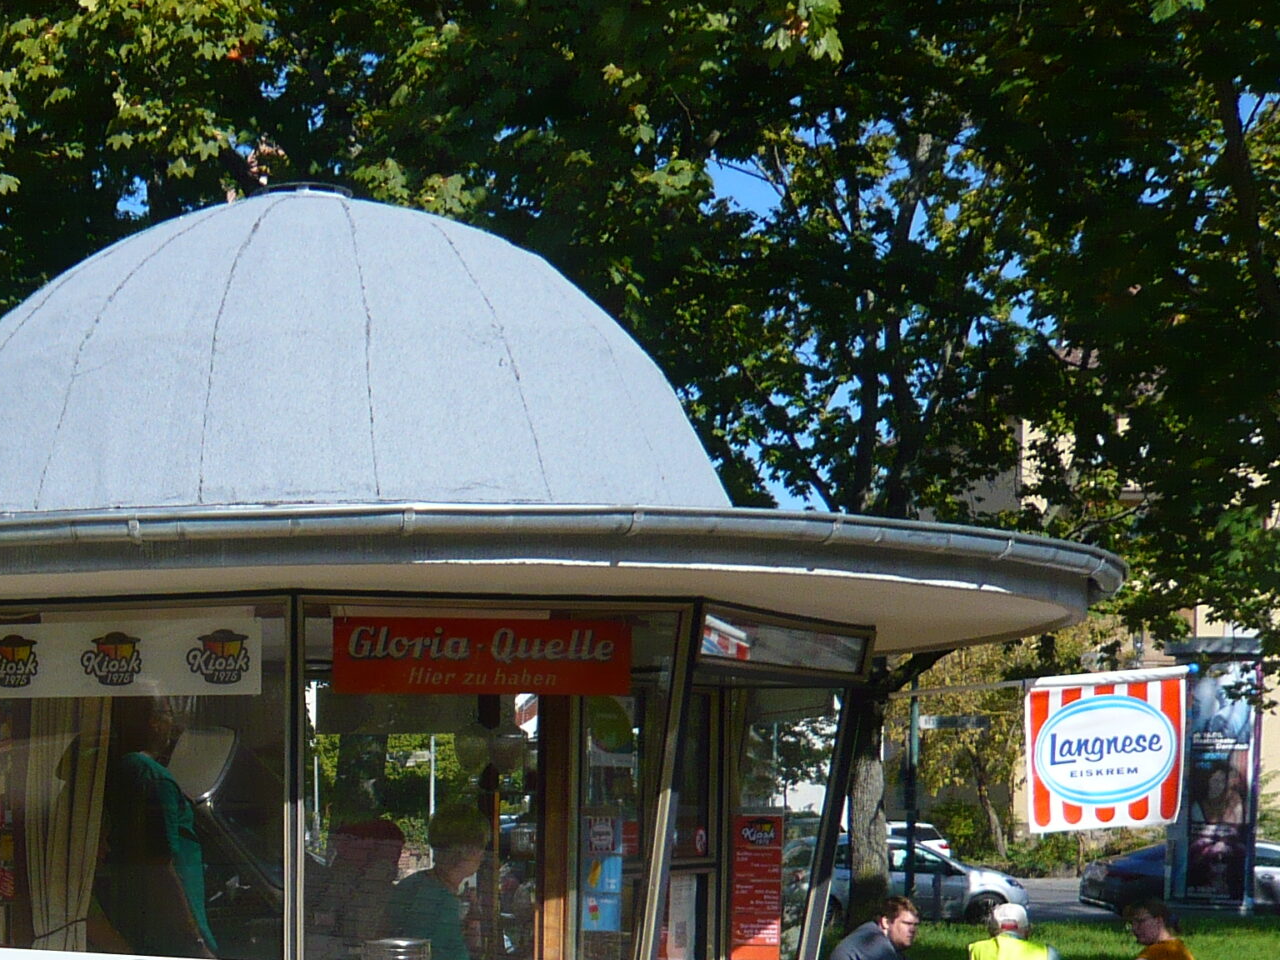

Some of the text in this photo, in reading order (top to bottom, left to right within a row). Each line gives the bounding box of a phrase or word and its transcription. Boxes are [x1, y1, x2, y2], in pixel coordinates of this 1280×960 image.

[349, 626, 471, 661] Gloria
[491, 627, 615, 664] Quelle
[82, 652, 141, 677] Kiosk
[188, 649, 249, 675] Kiosk
[408, 667, 557, 687] Hier zu haben
[1050, 732, 1163, 766] Langnese
[1069, 766, 1139, 778] EISKREM
